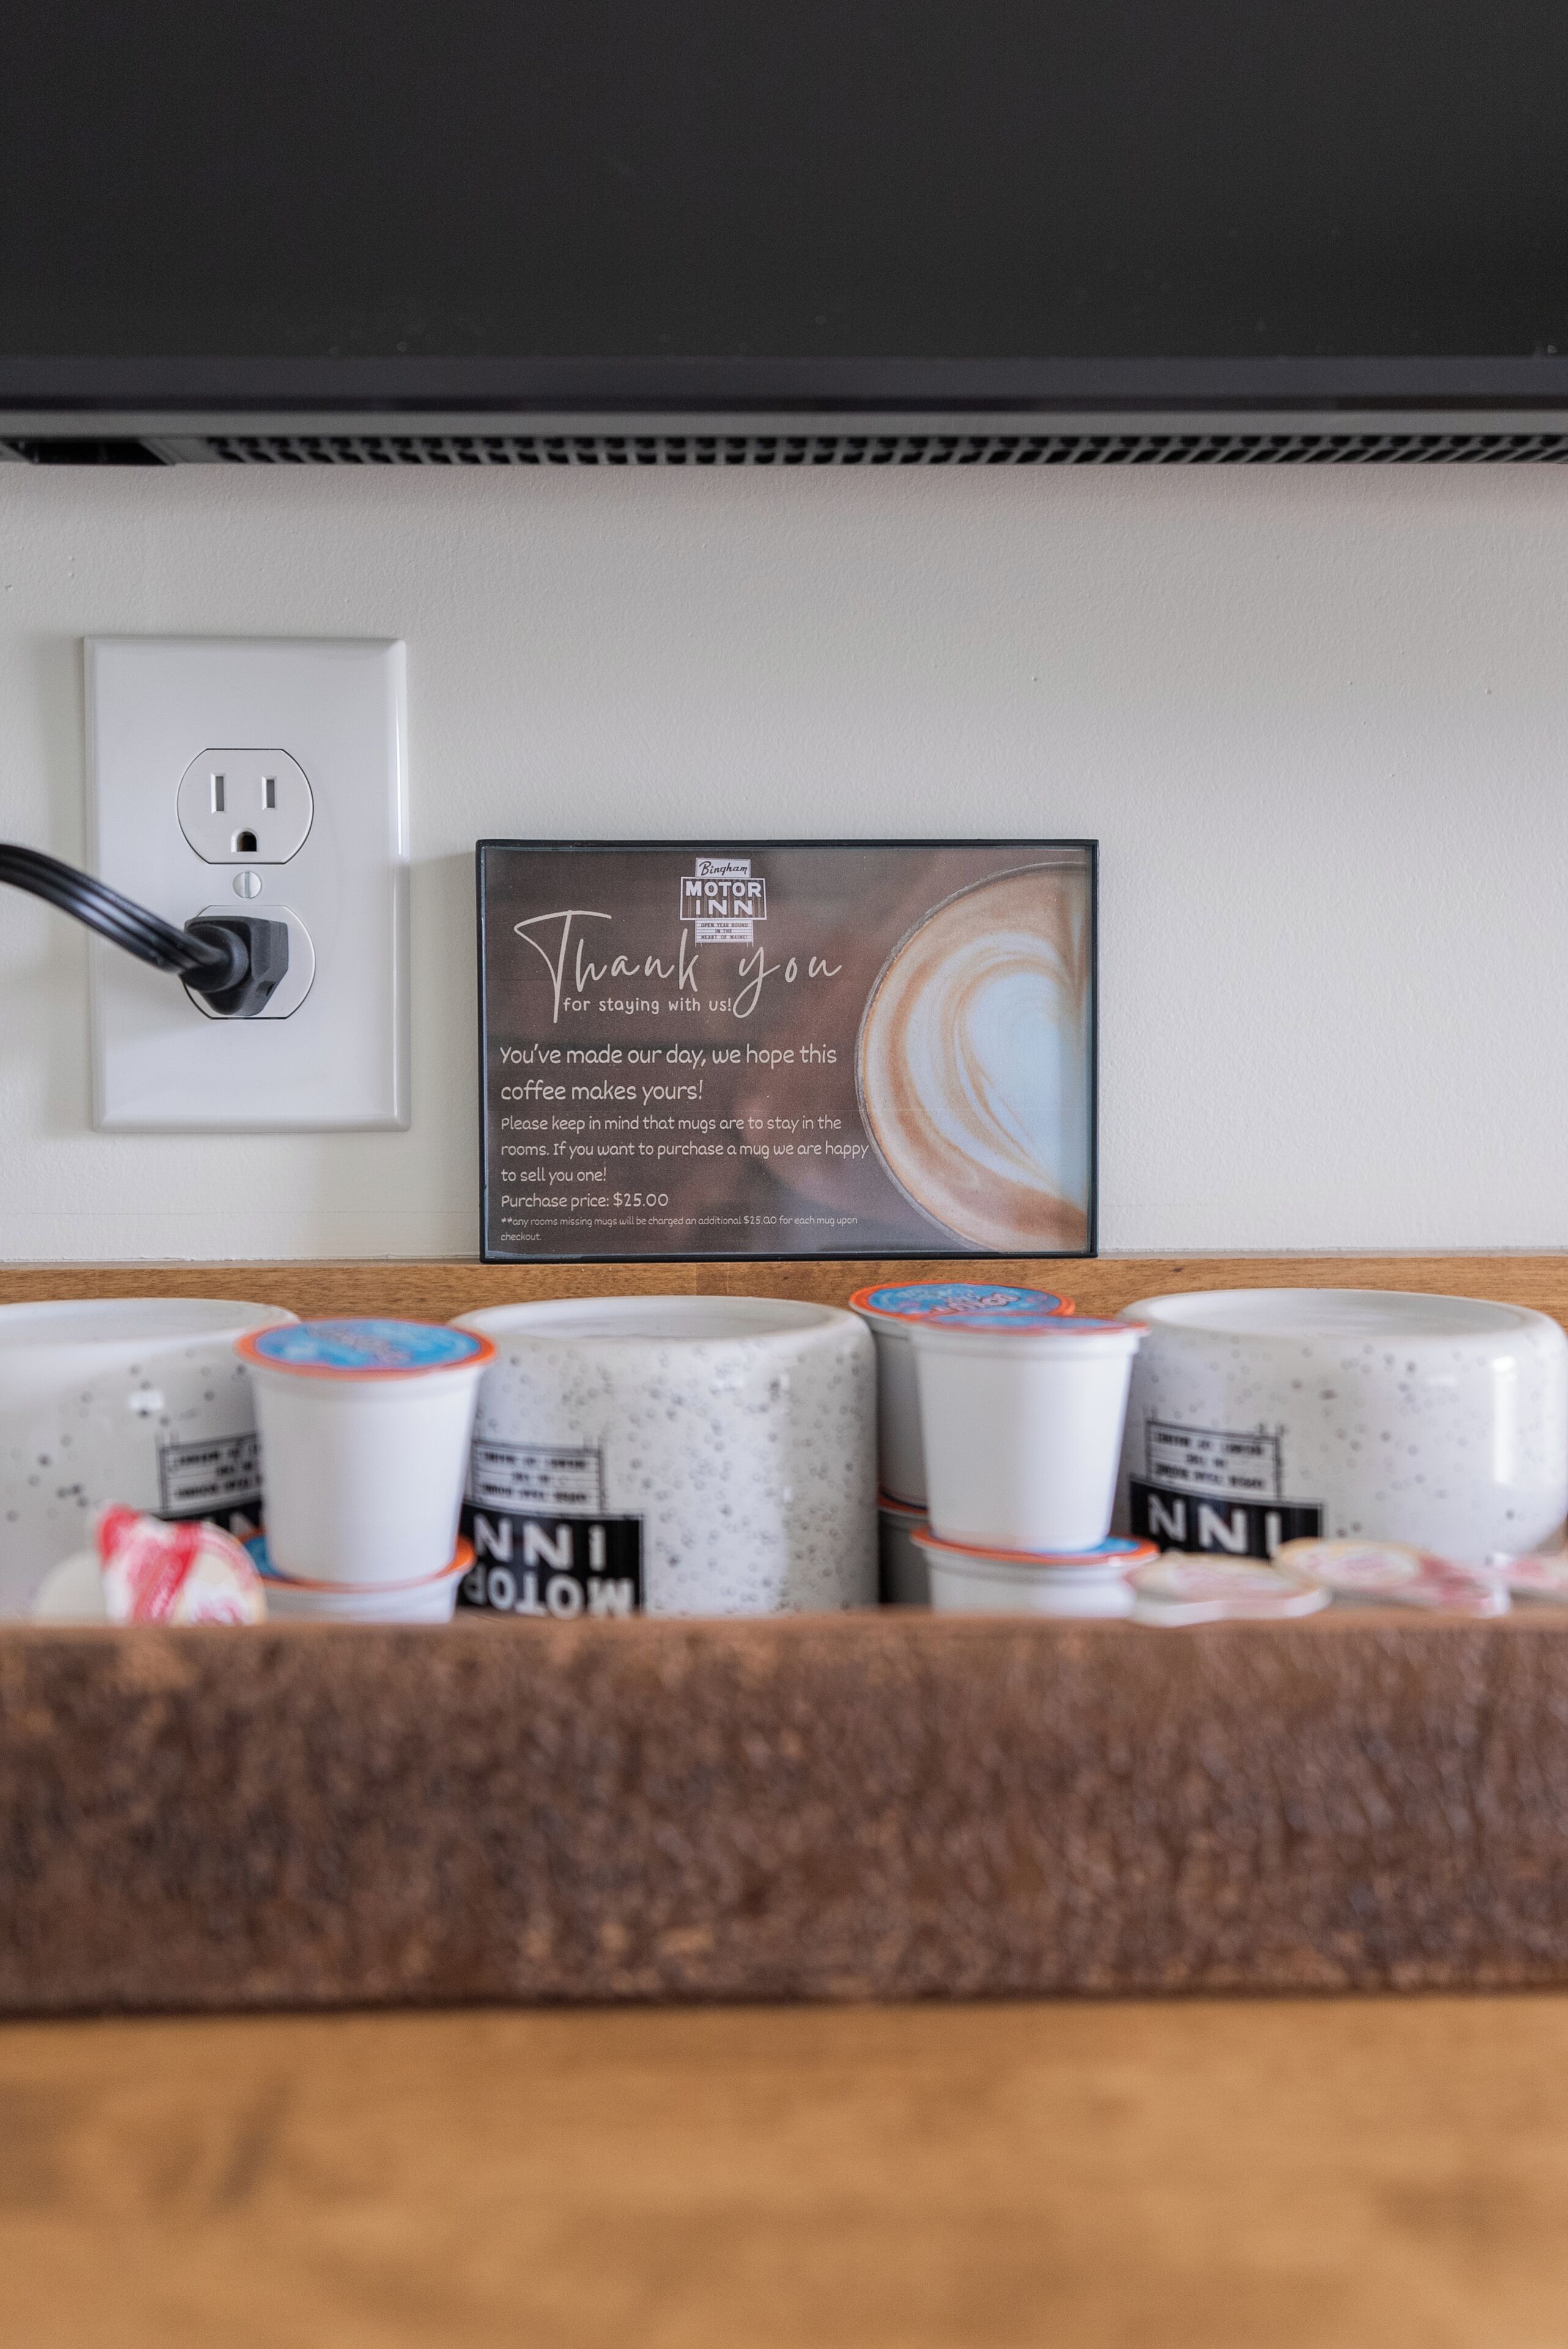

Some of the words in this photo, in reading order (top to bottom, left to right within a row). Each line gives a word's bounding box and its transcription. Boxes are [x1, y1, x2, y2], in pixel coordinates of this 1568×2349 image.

[699, 861, 748, 876] Bingham
[686, 881, 761, 897] MOTOR
[696, 899, 753, 915] INN
[513, 909, 699, 1023] Thank
[733, 946, 842, 1018] you
[563, 998, 591, 1011] for
[599, 998, 660, 1014] staying
[668, 998, 701, 1012] with
[709, 998, 731, 1012] us!
[566, 1044, 623, 1064] made
[627, 1049, 662, 1064] our
[666, 1044, 706, 1069] day,
[712, 1049, 741, 1063] we
[746, 1043, 794, 1069] hope
[799, 1043, 837, 1064] this
[501, 1079, 566, 1100] coffee
[572, 1080, 637, 1100] makes
[642, 1080, 703, 1106] yours!
[501, 1115, 548, 1130] Please
[552, 1115, 585, 1134] keep
[589, 1116, 601, 1129] in
[604, 1115, 639, 1130] mind
[642, 1115, 675, 1129] that
[678, 1119, 716, 1133] mugs
[719, 1119, 744, 1129] are
[747, 1116, 763, 1129] to
[767, 1116, 799, 1133] stay
[802, 1115, 814, 1129] in
[818, 1115, 841, 1129] the
[501, 1145, 549, 1156] rooms.
[553, 1141, 566, 1156] If
[569, 1145, 594, 1160] you
[597, 1143, 635, 1156] want
[638, 1143, 654, 1155] to
[657, 1141, 723, 1159] purchase
[727, 1145, 737, 1155] a
[739, 1145, 769, 1159] mug
[773, 1145, 794, 1155] we
[797, 1145, 822, 1155] are
[826, 1140, 869, 1159] happy
[501, 1169, 517, 1182] to
[520, 1167, 545, 1182] sell
[549, 1171, 573, 1186] you
[577, 1167, 607, 1182] one!
[501, 1193, 568, 1208] Purchase
[571, 1194, 609, 1211] price:
[613, 1192, 668, 1208] $25.00
[560, 1217, 592, 1227] missing
[594, 1218, 617, 1227] mugs
[619, 1216, 634, 1225] will
[636, 1216, 646, 1225] be
[648, 1216, 684, 1227] charged
[743, 1215, 777, 1224] $25.00
[779, 1215, 793, 1224] for
[794, 1215, 815, 1224] each
[817, 1218, 834, 1226] mug
[837, 1218, 857, 1226] upon
[501, 1231, 542, 1241] checkout.
[1147, 1493, 1282, 1556] INN
[473, 1512, 607, 1572] INN
